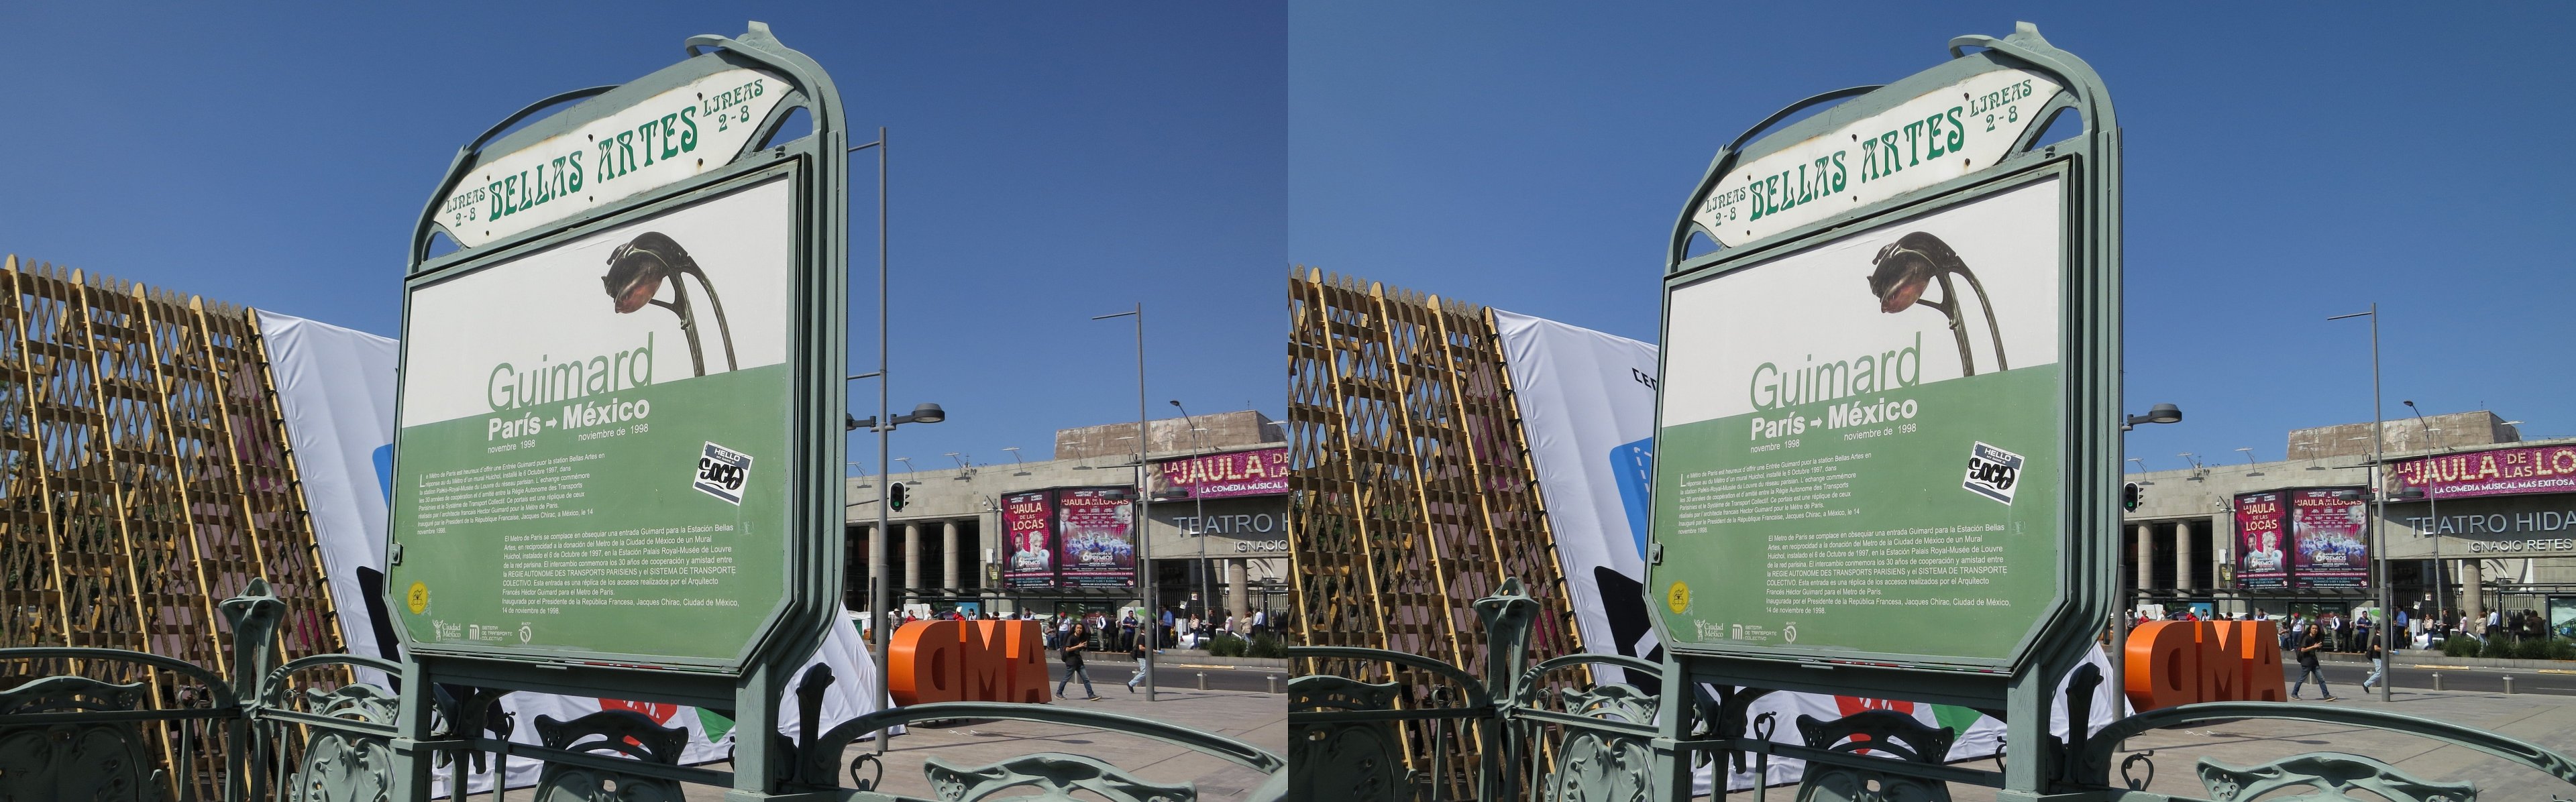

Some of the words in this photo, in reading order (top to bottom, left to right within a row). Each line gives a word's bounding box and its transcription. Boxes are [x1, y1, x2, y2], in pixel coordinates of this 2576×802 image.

[703, 79, 763, 117] LINEAS
[1970, 79, 2032, 117] LINEAS
[488, 151, 583, 222] BELLAS
[598, 106, 698, 184] ARTES
[1750, 150, 1846, 222] BELLAS
[1862, 106, 1964, 184] ARTES
[446, 187, 485, 213] LINEAS
[1706, 187, 1746, 213] LINEAS
[488, 331, 653, 412] Guimard
[1750, 331, 1921, 412] Guimard
[488, 412, 541, 441] París
[563, 398, 649, 430] México
[1751, 412, 1805, 441] París
[1828, 397, 1918, 430] México
[578, 427, 614, 441] noviembre
[616, 426, 625, 436] de
[630, 423, 648, 434] 1998
[1844, 426, 1881, 441] noviembre
[1883, 425, 1892, 436] de
[1898, 423, 1916, 434] 1998
[488, 442, 517, 453] novembre
[520, 440, 535, 449] 1998
[1750, 442, 1780, 453] novembre
[1784, 439, 1800, 449] 1998
[714, 449, 740, 461] HELLO
[1984, 448, 2011, 461] HELLO
[2506, 453, 2526, 464] DE
[1165, 463, 1179, 473] LA
[1174, 454, 1267, 485] JAULA
[2398, 463, 2412, 474] LA
[2407, 454, 2500, 484] JAULA
[2505, 465, 2533, 478] LAS
[1248, 482, 1283, 491] MUSICAL
[2446, 484, 2480, 493] COMEDIA
[2482, 482, 2517, 491] MUSICAL
[2538, 479, 2575, 487] EXITOSA
[1014, 503, 1042, 514] JAULA
[2247, 503, 2275, 514] JAULA
[1013, 519, 1044, 530] LOCAS
[1173, 514, 1272, 537] TEATRO
[2246, 520, 2277, 531] LOCAS
[2406, 514, 2507, 537] TEATRO
[550, 532, 573, 541] complace
[581, 530, 606, 539] obsequiar
[687, 525, 713, 533] Estación
[1234, 540, 1288, 551] IGNACIO
[2468, 540, 2522, 551] IGNACIO
[2527, 538, 2573, 550] RETES
[1766, 598, 1791, 606] Inaugurada
[1848, 598, 1874, 607] República
[1876, 598, 1902, 606] Francesa,
[1905, 598, 1928, 607] Jacques
[1930, 598, 1951, 607] Chirac,
[1986, 598, 2010, 607] México,
[442, 623, 461, 631] Ciudad
